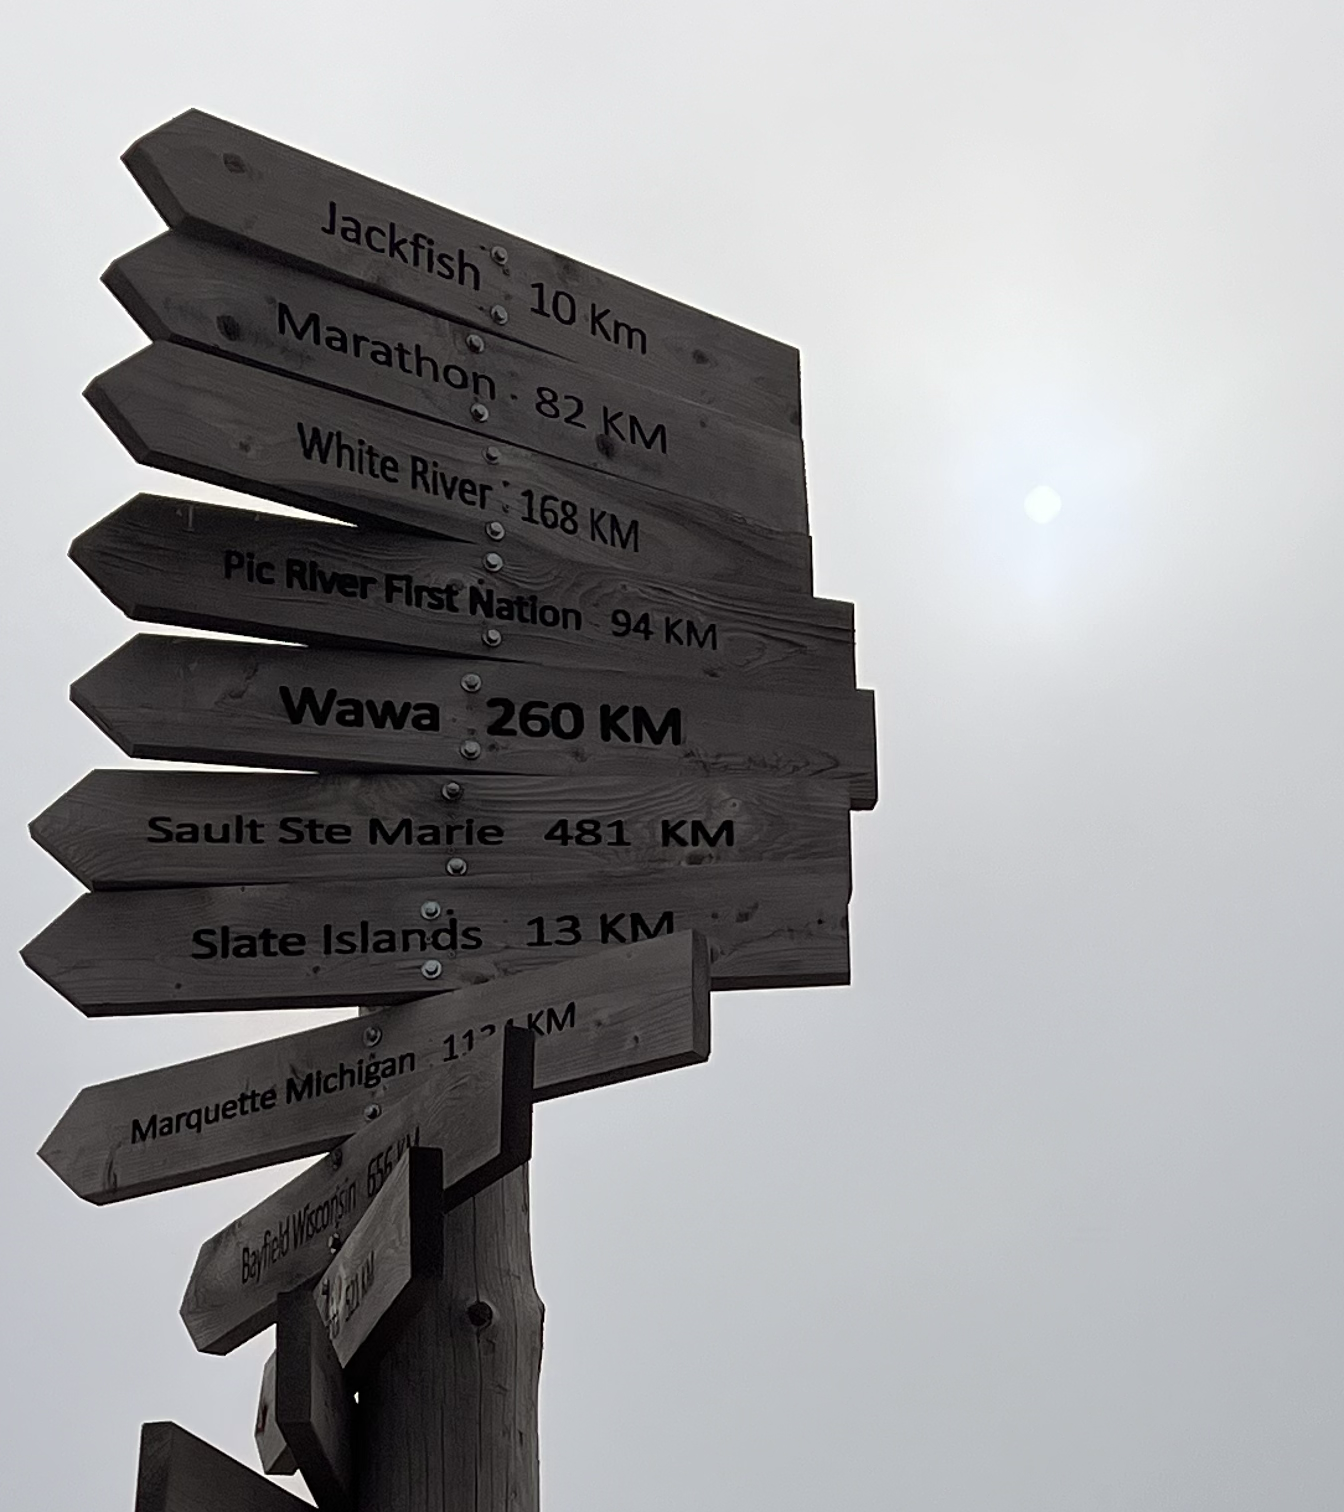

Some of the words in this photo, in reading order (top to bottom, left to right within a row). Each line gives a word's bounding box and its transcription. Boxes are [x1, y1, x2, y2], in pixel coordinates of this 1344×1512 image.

[321, 201, 480, 290] Jackfish
[530, 282, 577, 325] 10
[589, 302, 647, 354] Km
[277, 303, 496, 401] Marathon
[535, 386, 586, 428] 82
[602, 404, 666, 453] KM
[296, 422, 400, 483] White
[410, 453, 492, 508] River
[520, 489, 579, 535] 168
[588, 508, 640, 554] KM
[223, 550, 275, 584] Pic
[285, 557, 377, 600] River
[385, 574, 459, 613] First
[468, 586, 583, 631] Nation
[610, 608, 654, 640] 94
[664, 616, 718, 651] KM
[278, 686, 441, 732] Wawa
[485, 697, 585, 740] 260
[599, 704, 683, 747] KM
[146, 814, 265, 846] Sault
[278, 816, 353, 846] Ste
[369, 817, 505, 848] Marie
[543, 818, 633, 848] 481
[661, 819, 736, 848] KM
[191, 925, 307, 959] Slate
[322, 919, 483, 956] Islands
[526, 914, 582, 948] 13
[599, 911, 675, 944] KM
[130, 1086, 278, 1145] Marquette
[285, 1051, 417, 1104] Michigan
[527, 1001, 577, 1036] KM
[242, 1214, 290, 1284] Bayfield
[291, 1178, 357, 1250] Wisconsin
